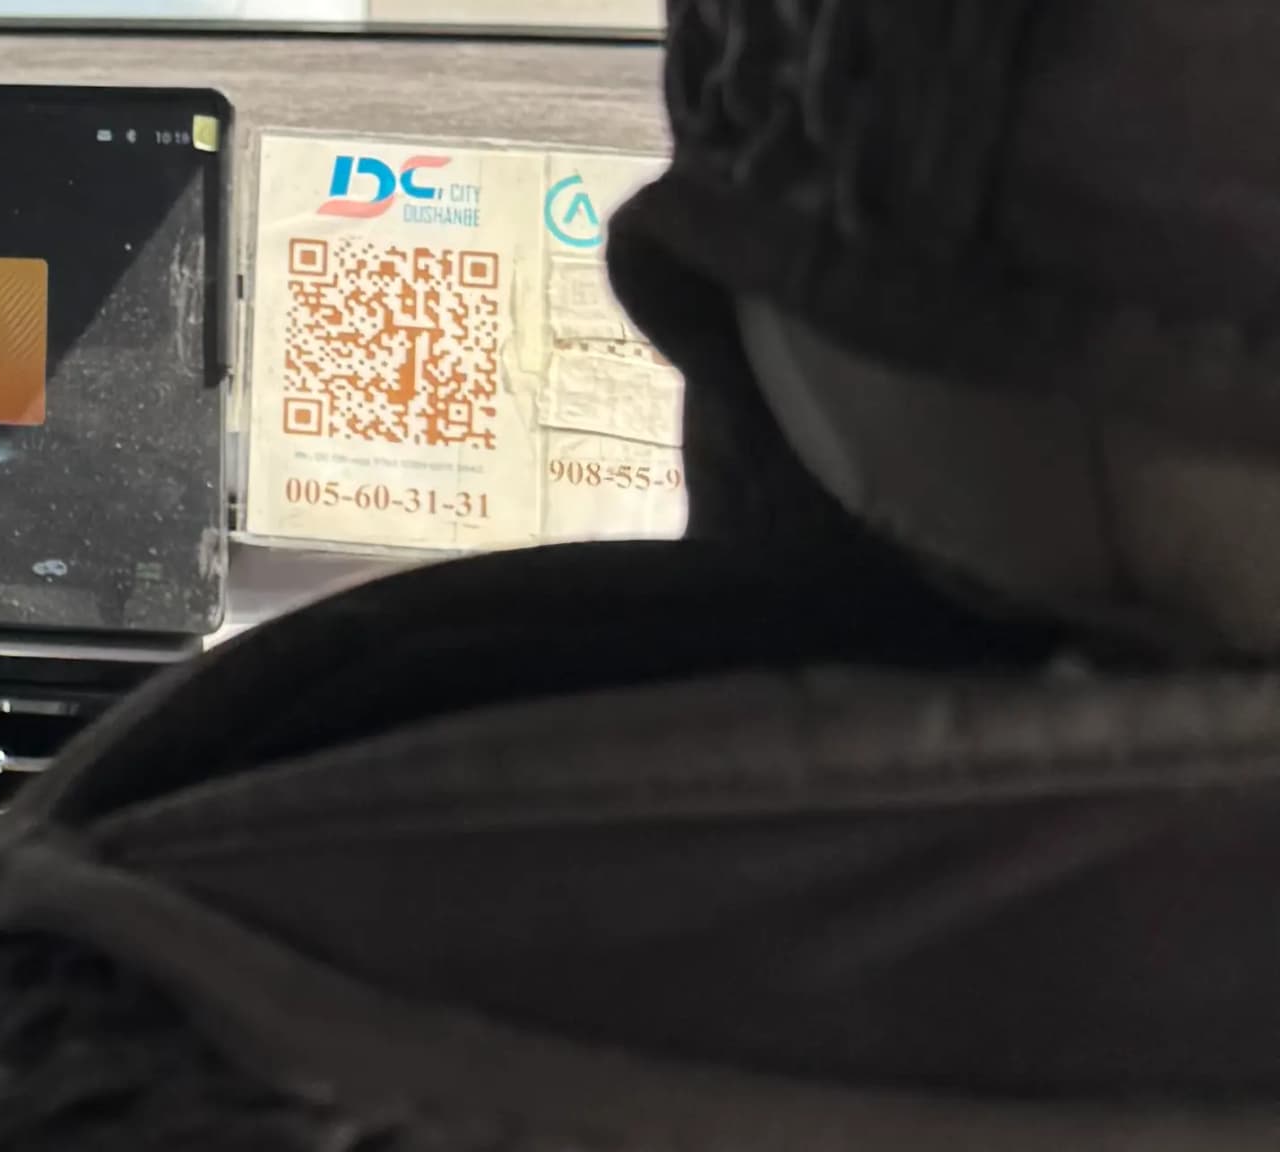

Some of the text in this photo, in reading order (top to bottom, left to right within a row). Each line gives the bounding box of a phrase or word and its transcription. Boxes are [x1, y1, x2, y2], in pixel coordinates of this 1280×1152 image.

[449, 183, 481, 203] CITY
[403, 203, 480, 227] DUSHANBE
[285, 477, 490, 519] 005-60-31-31
